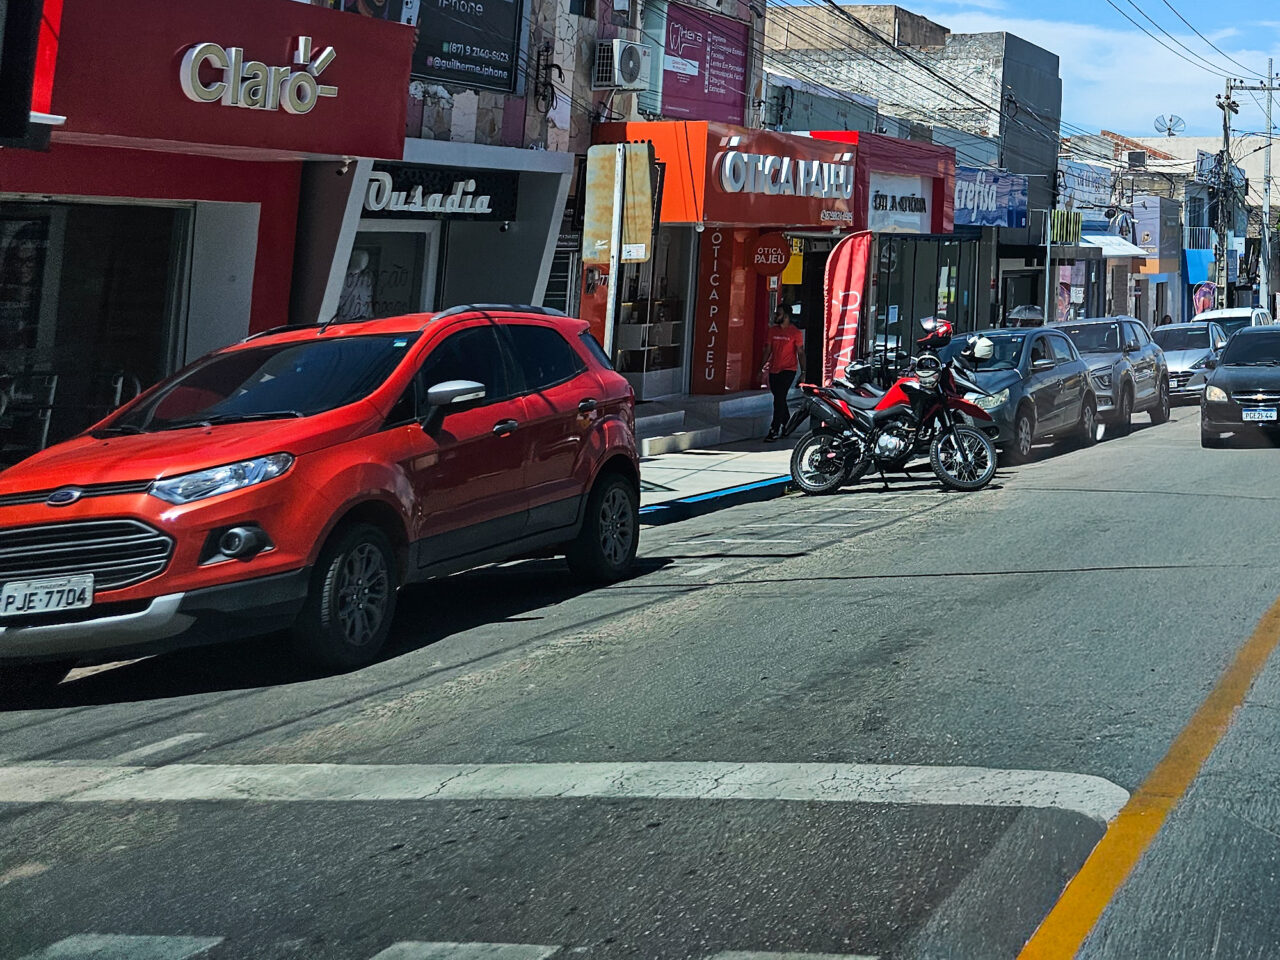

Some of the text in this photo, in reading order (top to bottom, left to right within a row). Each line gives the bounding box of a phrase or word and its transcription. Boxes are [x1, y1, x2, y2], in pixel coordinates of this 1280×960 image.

[180, 40, 326, 114] Claro
[364, 171, 493, 213] Ousadia
[720, 136, 854, 200] ÓTICA PAJEÚ
[954, 171, 997, 222] crefisa
